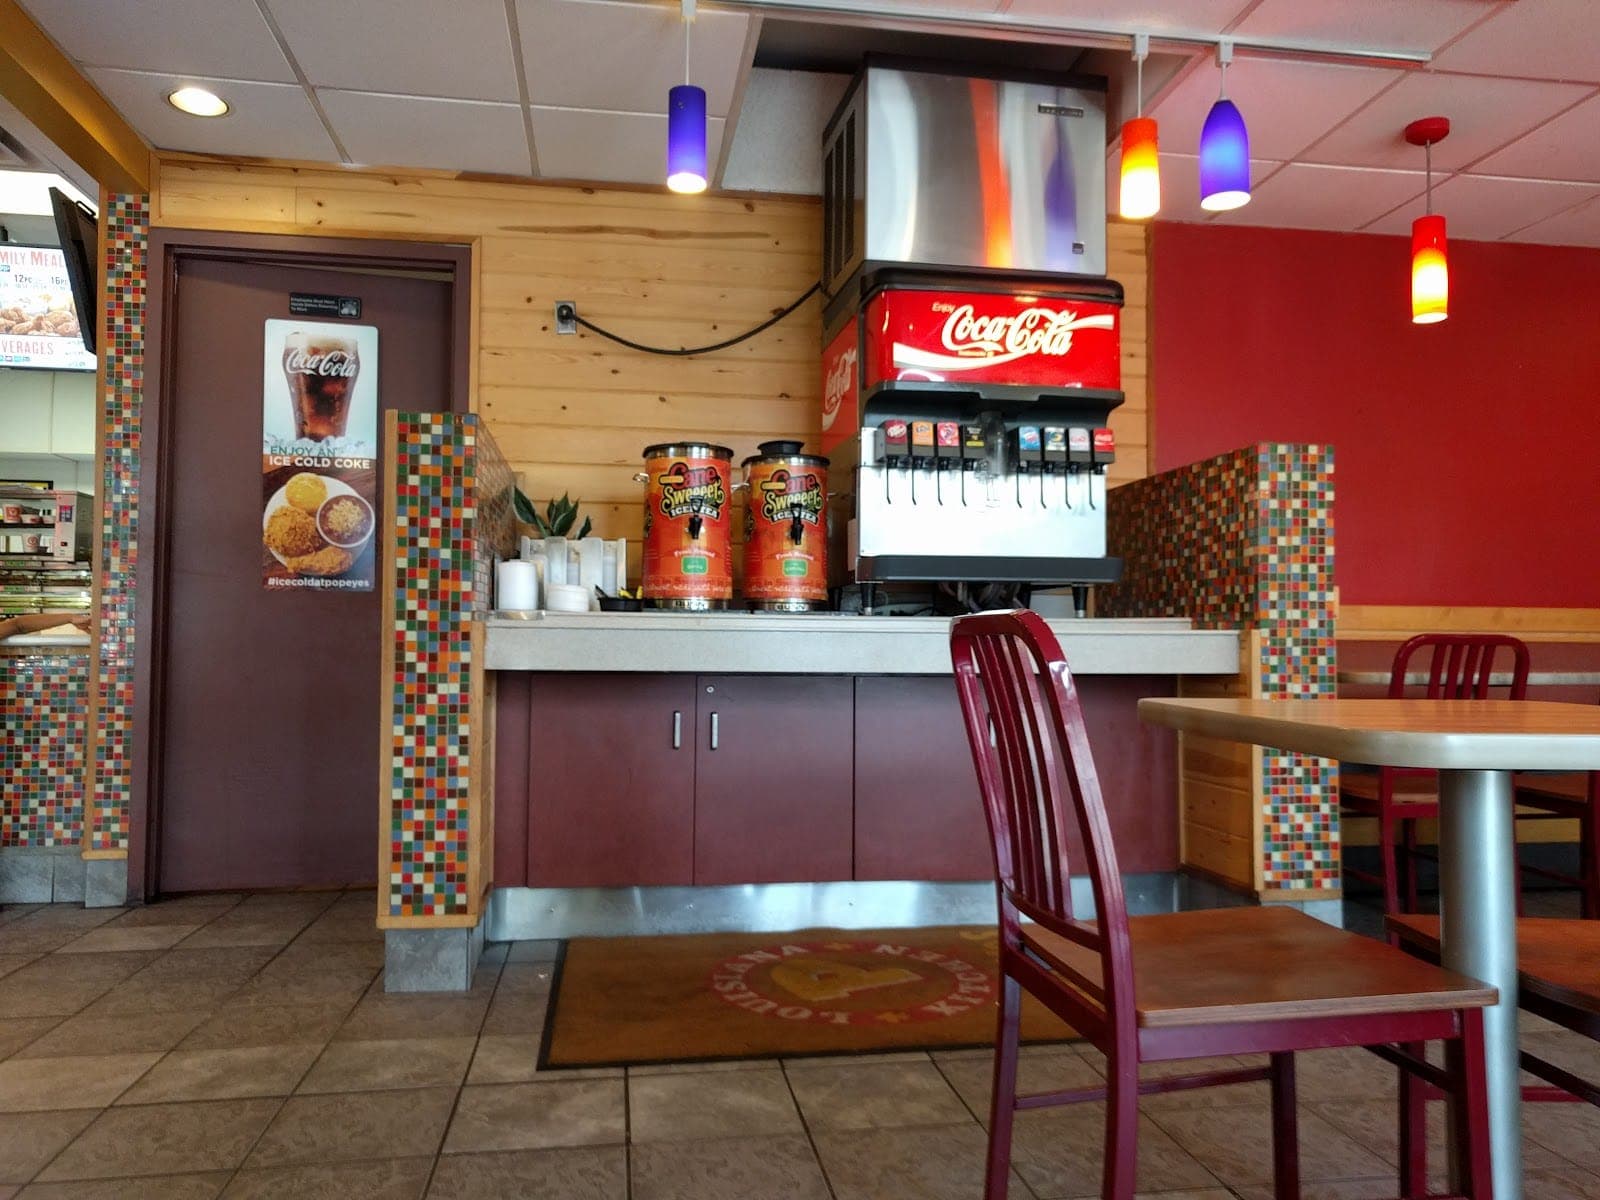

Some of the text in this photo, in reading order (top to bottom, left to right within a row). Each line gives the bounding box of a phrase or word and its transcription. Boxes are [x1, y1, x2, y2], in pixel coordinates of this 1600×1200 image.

[941, 304, 1078, 356] Coca-Cola
[286, 349, 358, 378] Coca-Cola
[270, 445, 336, 457] ENJOY AN
[269, 456, 370, 470] ICE COLD COKE
[268, 576, 369, 588] #icecoldatpopeyes
